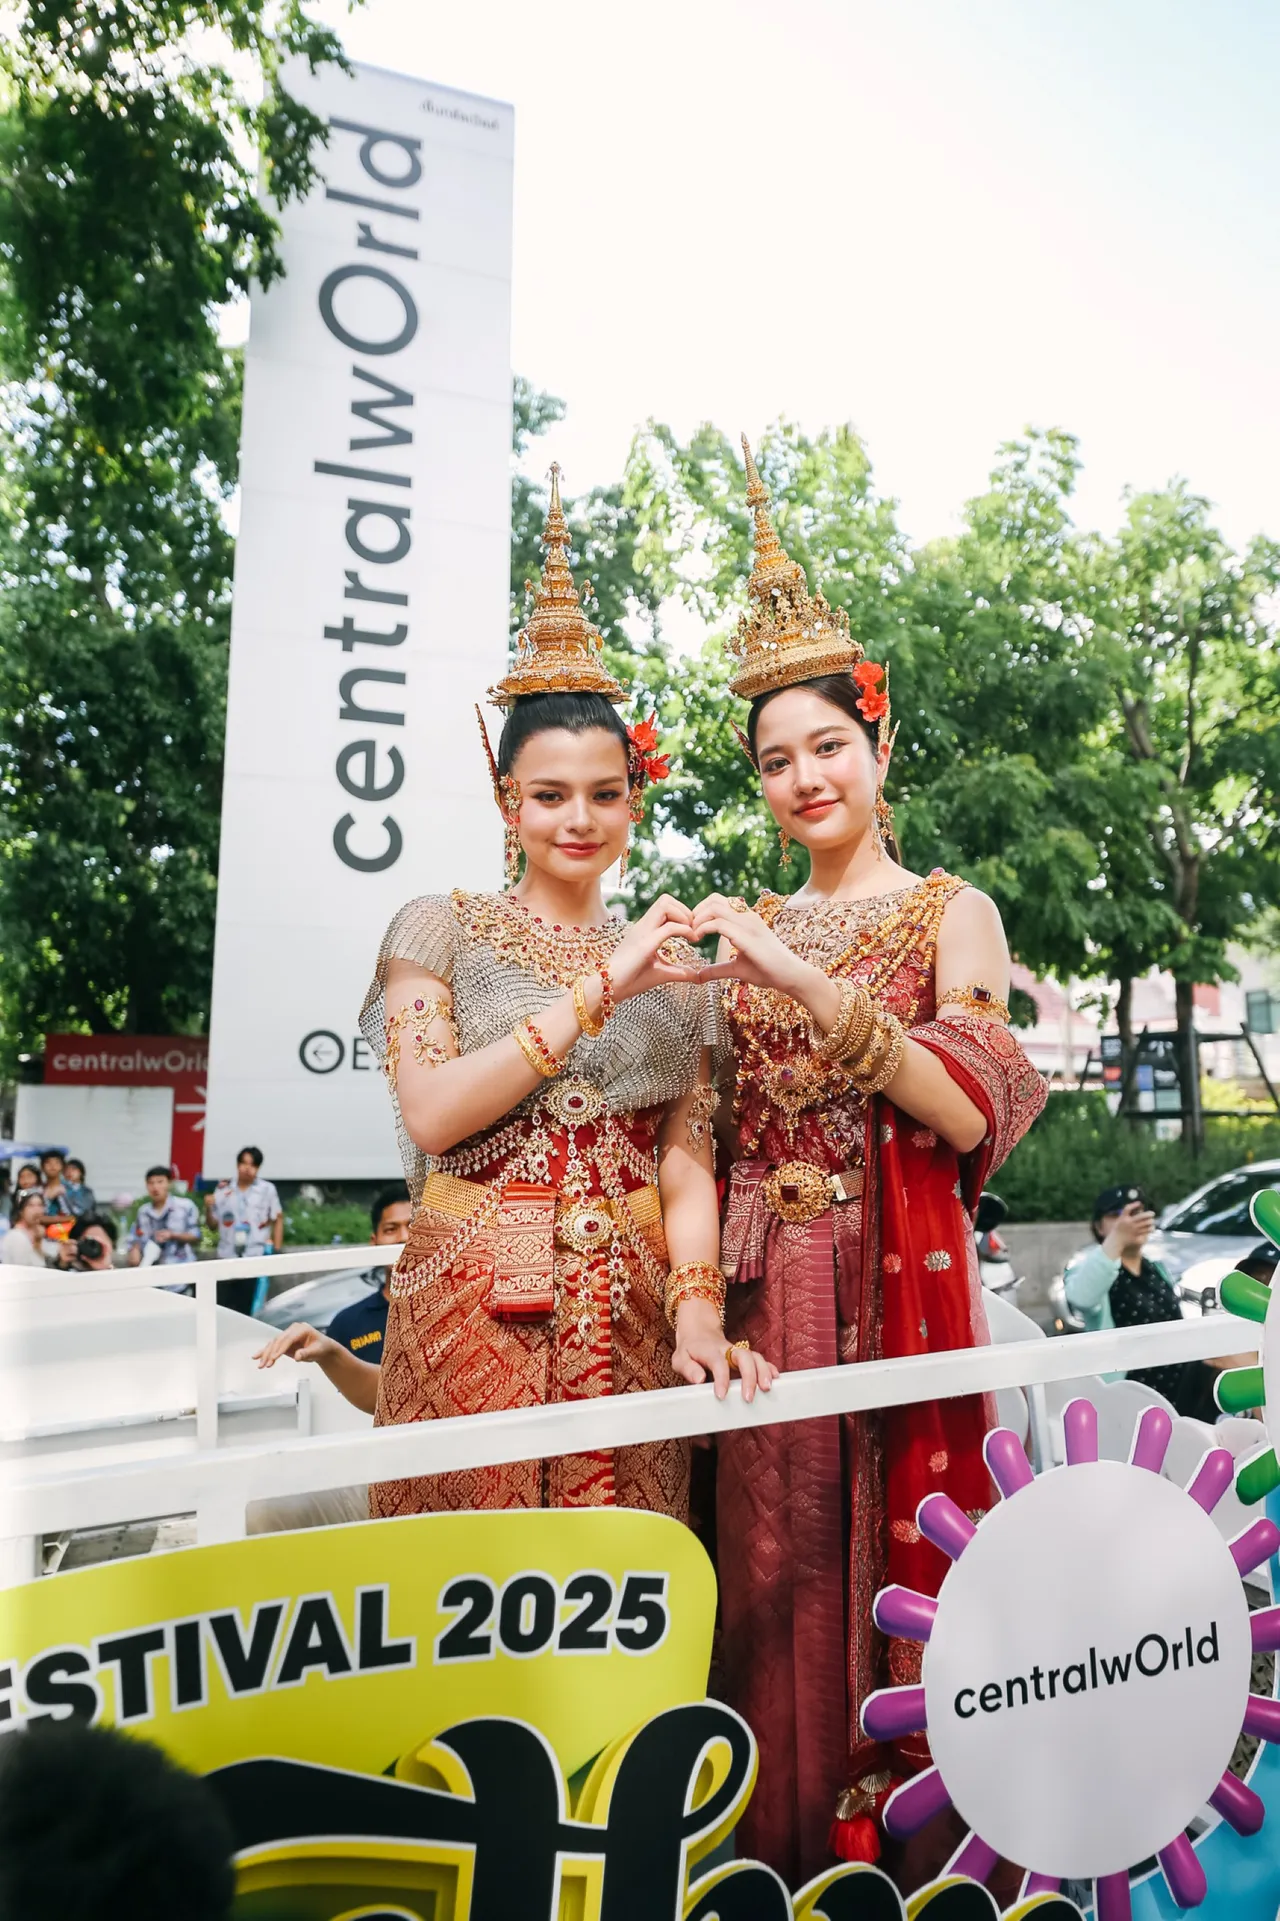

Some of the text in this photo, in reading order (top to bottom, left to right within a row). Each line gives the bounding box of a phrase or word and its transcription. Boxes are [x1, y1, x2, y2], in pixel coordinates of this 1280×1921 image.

[314, 115, 424, 873] centralwOrld
[437, 1576, 667, 1660] 2025
[953, 1621, 1220, 1719] centralwOrld
